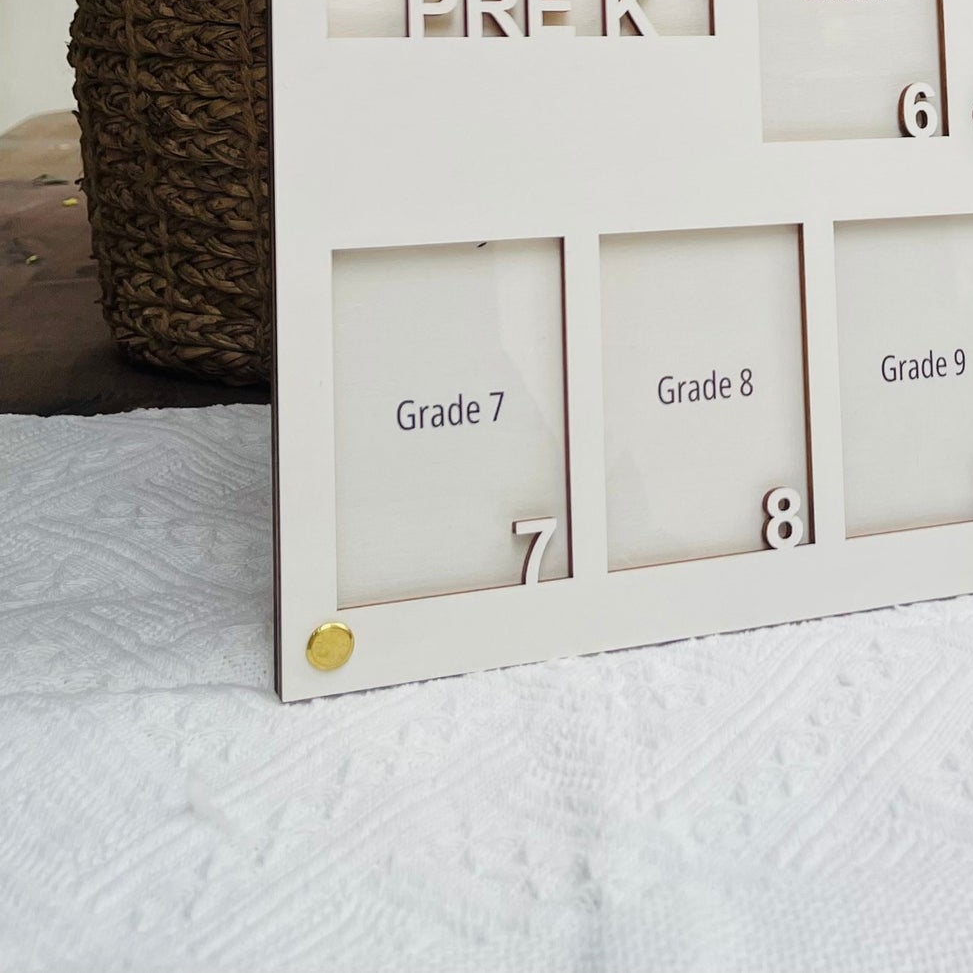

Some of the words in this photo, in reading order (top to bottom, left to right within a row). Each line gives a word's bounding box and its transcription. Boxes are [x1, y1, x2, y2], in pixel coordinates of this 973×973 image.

[898, 81, 939, 139] 6
[657, 369, 732, 405] Grade
[739, 367, 754, 397] 8
[881, 349, 948, 383] Grade
[953, 348, 966, 376] 9
[396, 393, 481, 431] Grade
[489, 391, 505, 422] 7
[763, 486, 804, 550] 8
[512, 516, 557, 585] 7
